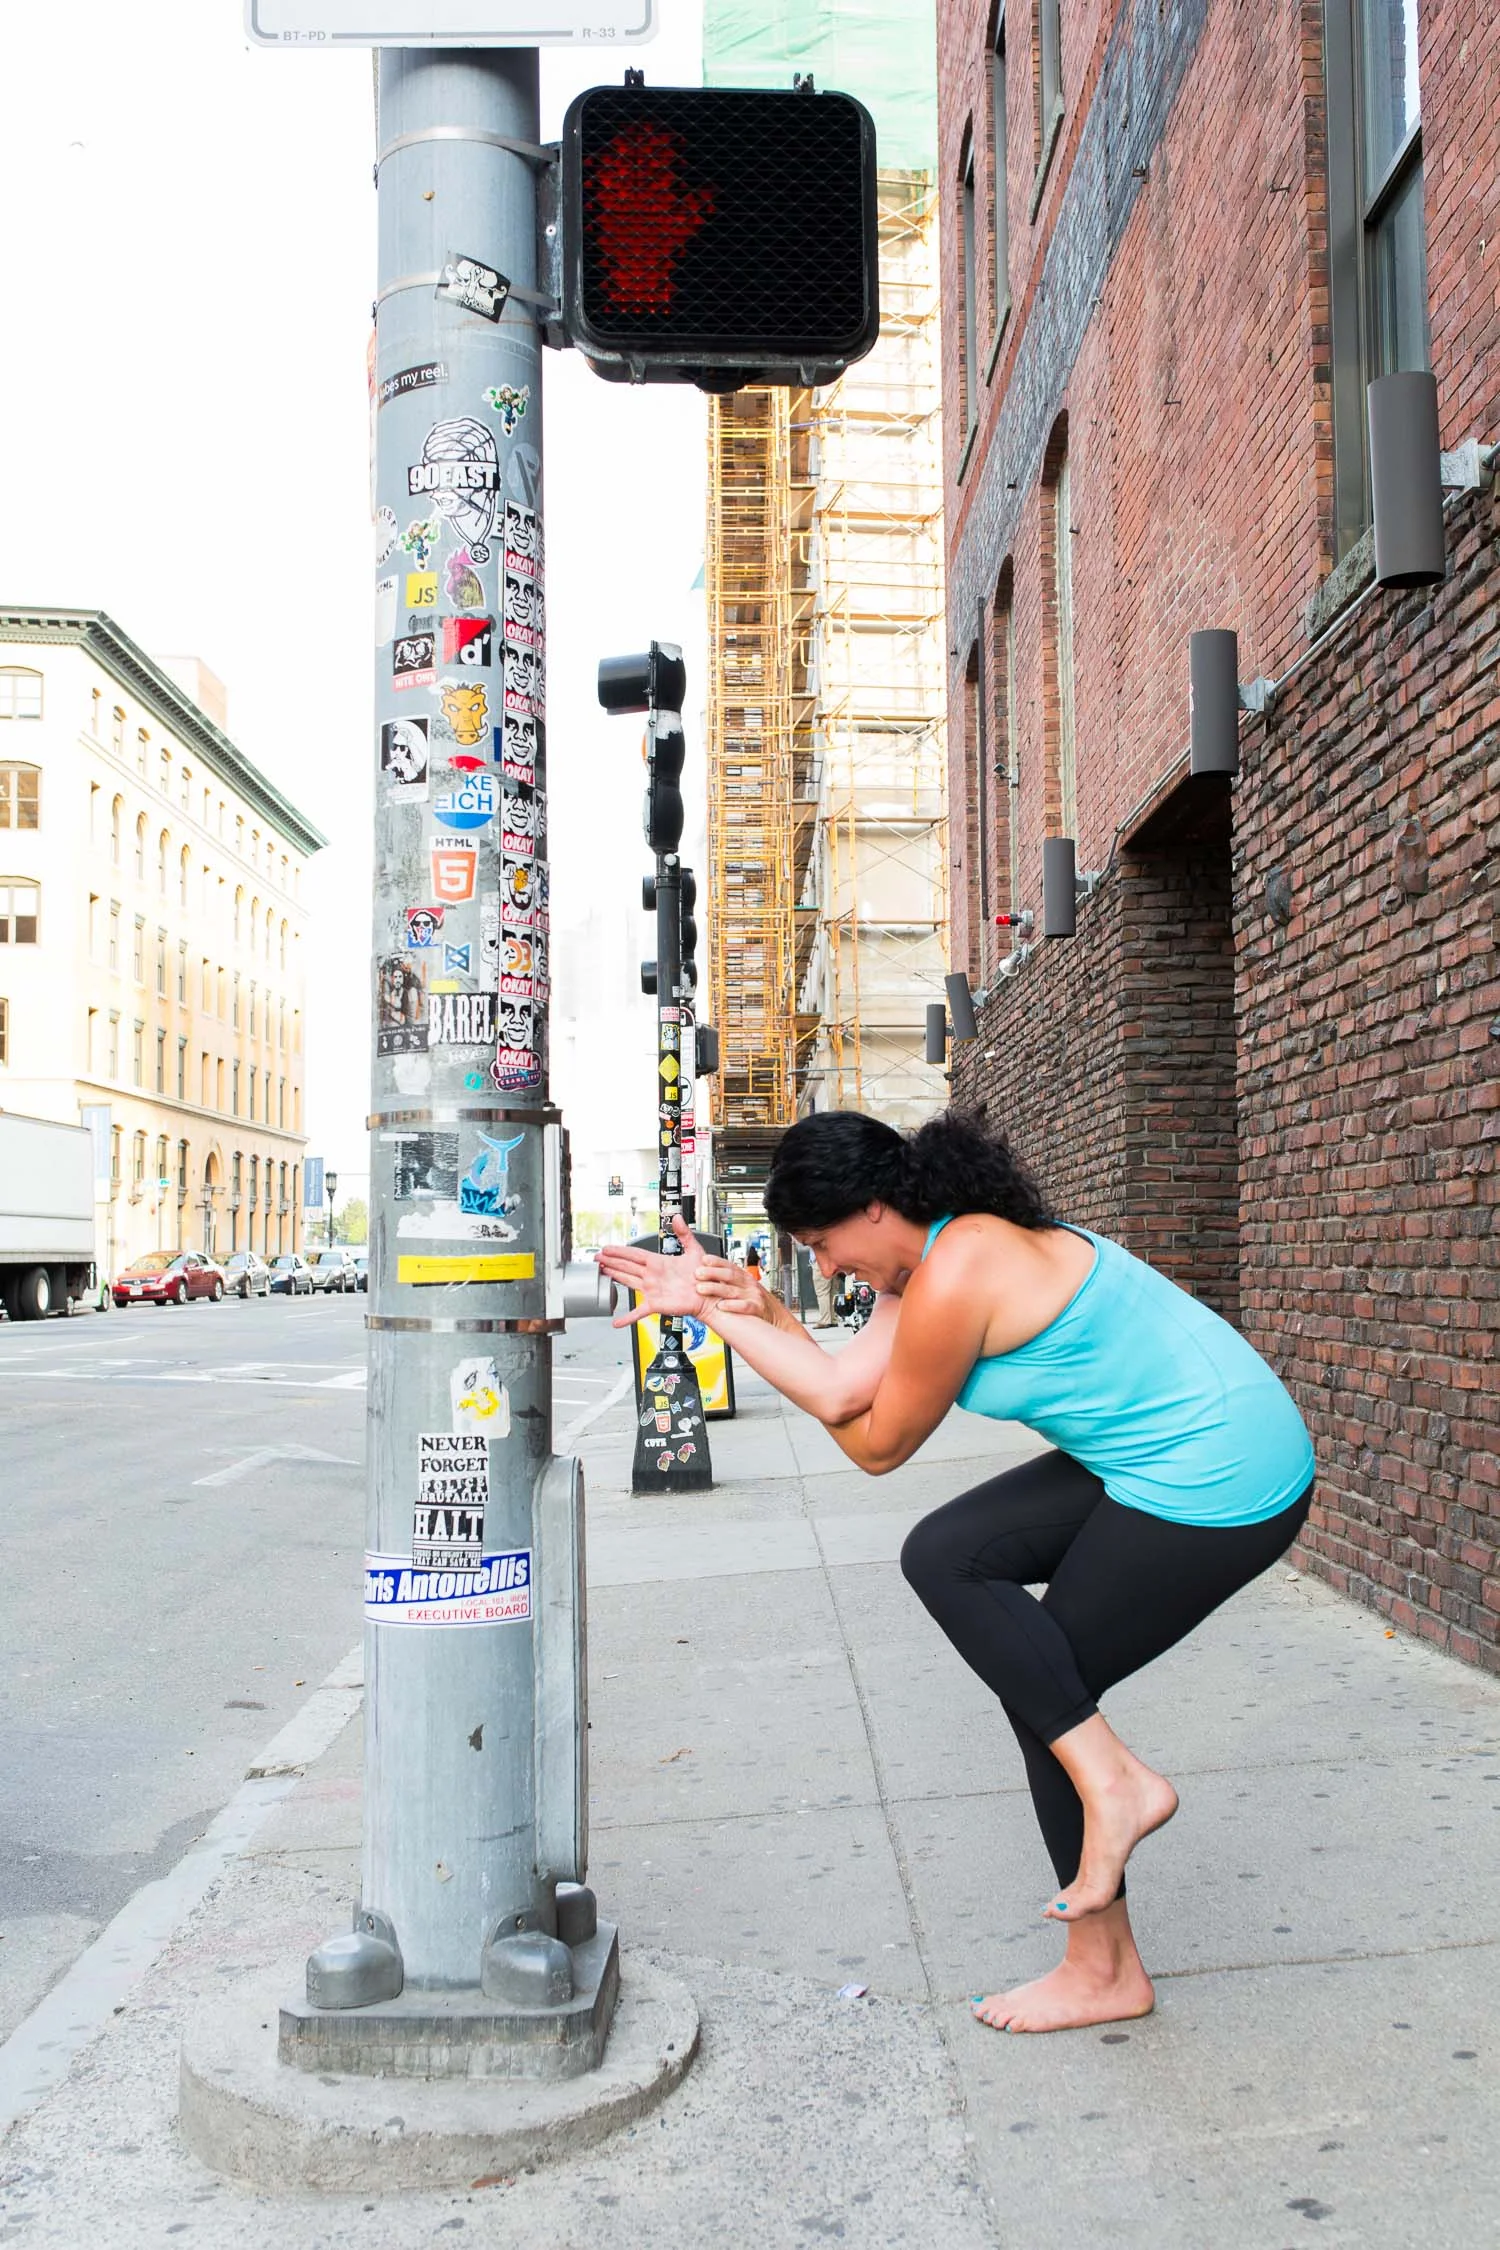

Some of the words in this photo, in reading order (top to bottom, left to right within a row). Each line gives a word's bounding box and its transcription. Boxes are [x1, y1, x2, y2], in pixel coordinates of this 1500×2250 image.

[282, 31, 327, 41] BT-PD
[582, 27, 616, 38] R-33
[401, 371, 418, 386] my
[409, 464, 497, 494] 90EAST
[472, 547, 489, 559] GS
[507, 552, 535, 575] OKAY
[413, 586, 435, 605] JS
[506, 622, 535, 645] OKAY
[504, 762, 533, 784] OKAY
[435, 837, 473, 848] HTML
[503, 833, 533, 855] OKAY
[438, 858, 469, 894] 5
[501, 977, 532, 995] OKAY
[500, 1049, 530, 1067] OKAY
[421, 1435, 487, 1452] NEVER
[420, 1457, 489, 1473] FORGET
[422, 1477, 486, 1493] POLICE
[421, 1490, 489, 1503] BRUTALITY
[413, 1509, 484, 1542] HALT
[413, 1557, 430, 1566] THAT
[432, 1557, 448, 1567] CAN
[449, 1558, 468, 1567] SAVE
[396, 1558, 528, 1602] Antonellis
[407, 1607, 482, 1621] EXECUTIVE
[485, 1602, 528, 1618] BOARD
